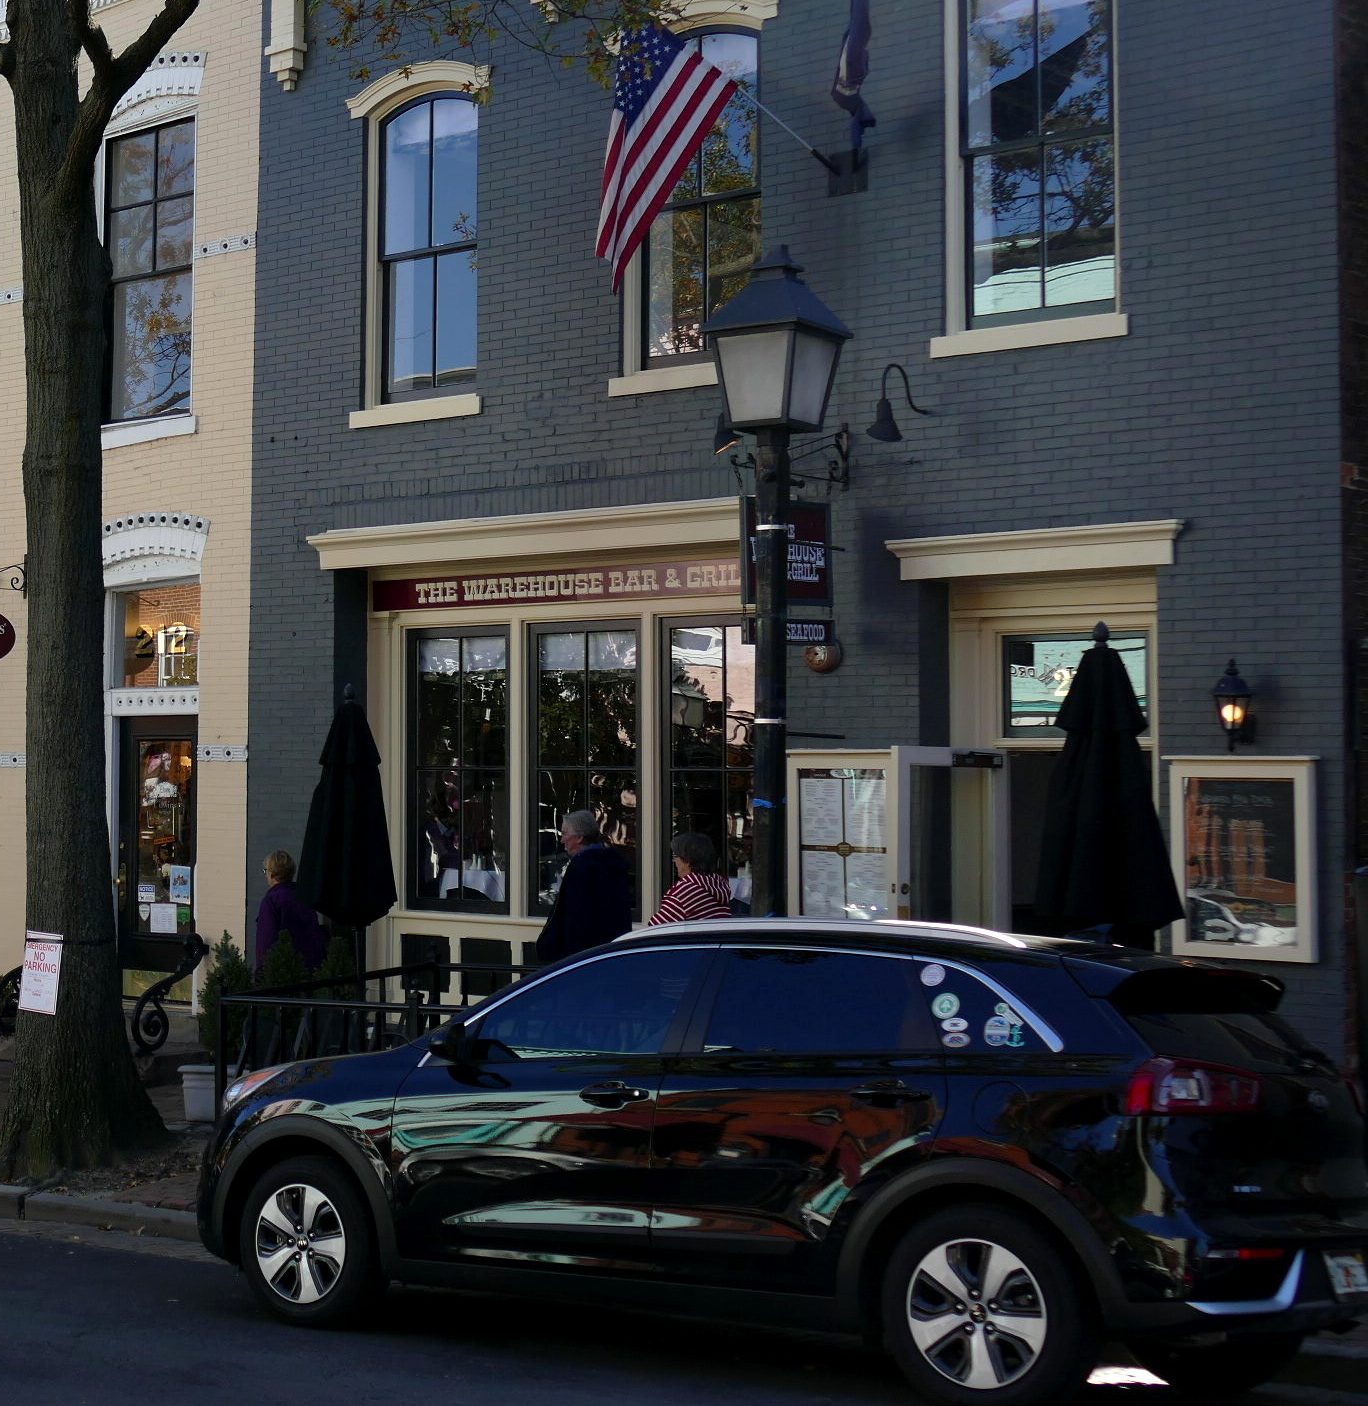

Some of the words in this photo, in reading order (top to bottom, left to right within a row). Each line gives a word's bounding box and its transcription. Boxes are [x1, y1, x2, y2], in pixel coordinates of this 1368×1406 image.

[792, 563, 820, 583] GRILL
[416, 582, 458, 604] THE
[462, 573, 603, 600] WAREHOUSE
[608, 569, 658, 592] BAR
[665, 568, 681, 588] &
[687, 563, 741, 587] GRIL
[786, 622, 825, 642] SEAFOOD
[24, 959, 57, 974] PARKING
[33, 951, 46, 962] NO
